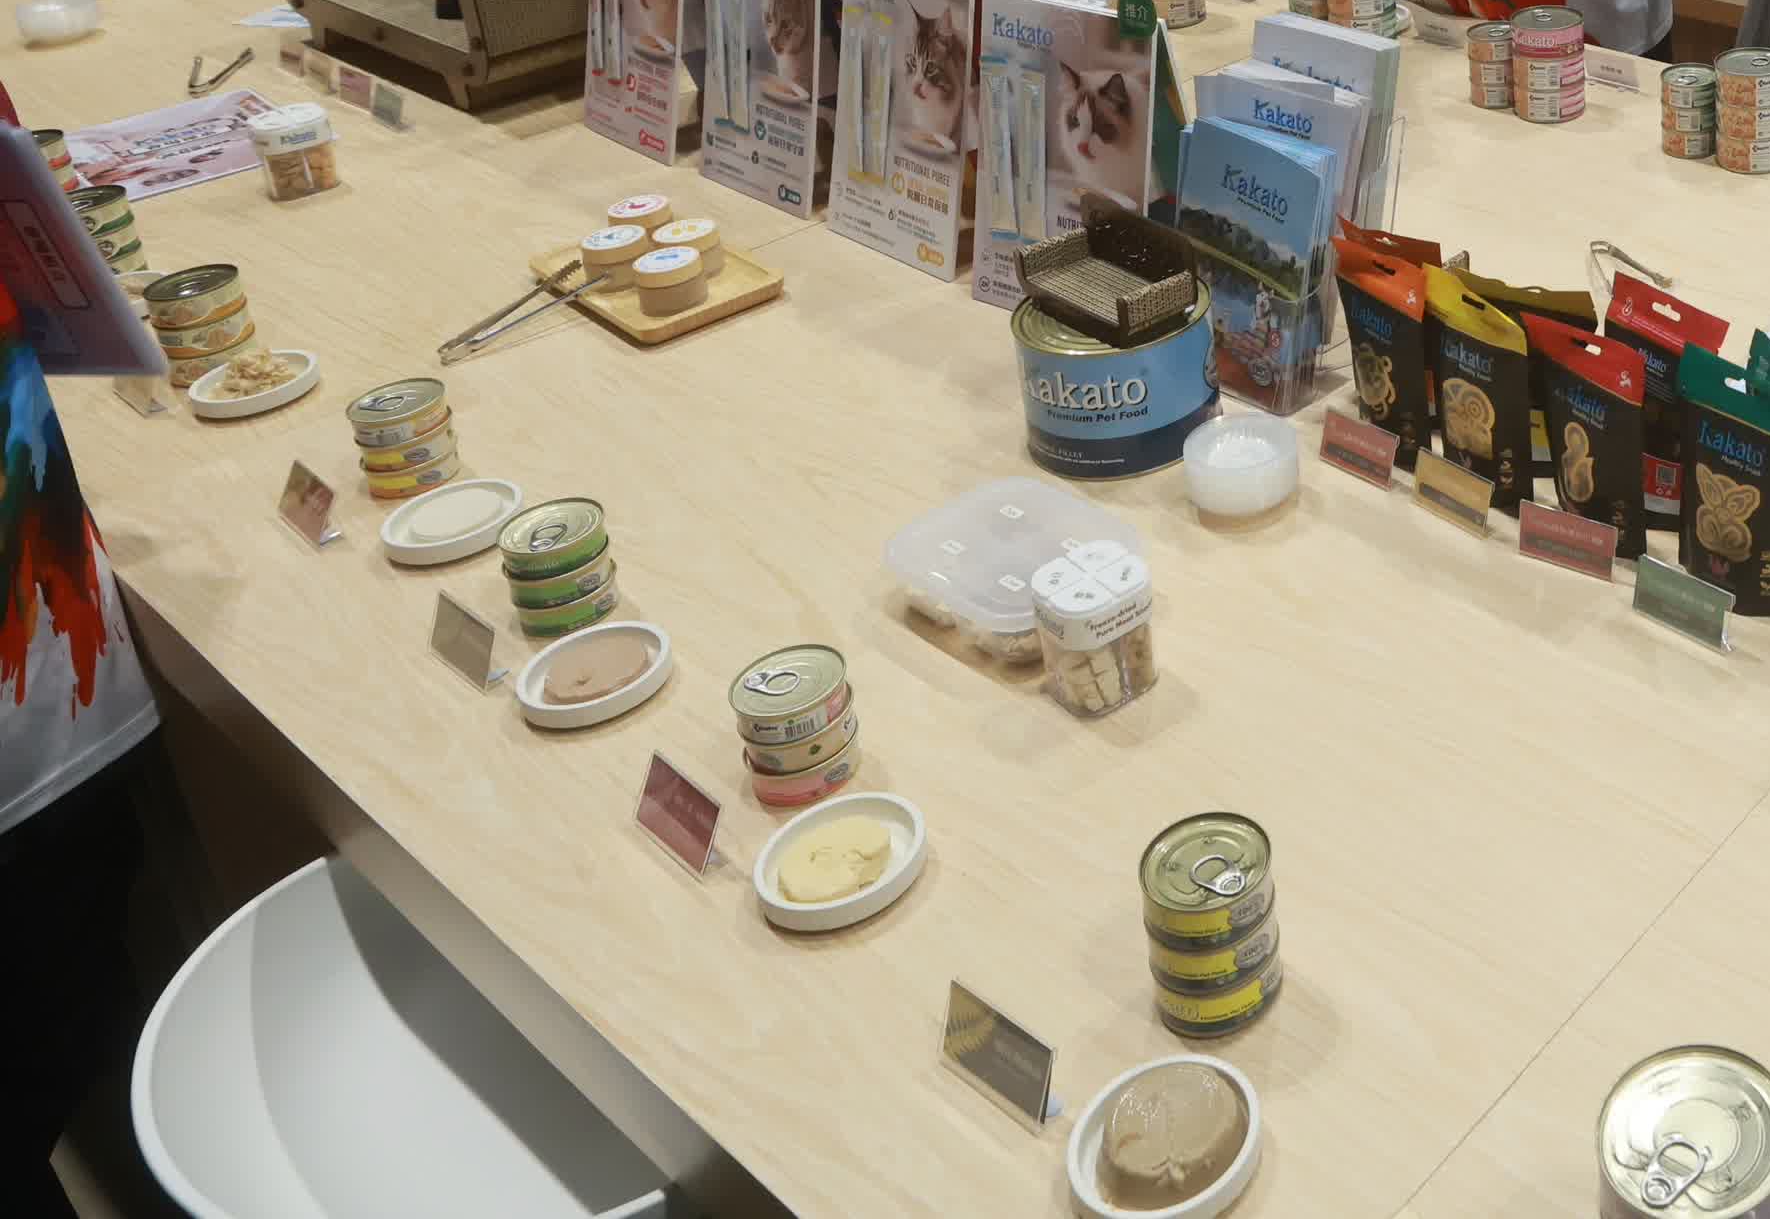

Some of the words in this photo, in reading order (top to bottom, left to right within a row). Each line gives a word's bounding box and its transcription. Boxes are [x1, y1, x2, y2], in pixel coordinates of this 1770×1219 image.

[991, 11, 1055, 47] Kakato
[1125, 2, 1150, 21] 推介
[1253, 98, 1314, 134] Kakato
[1219, 163, 1290, 217] Kakato
[1047, 409, 1094, 423] Premium
[1096, 409, 1116, 422] Pet
[1119, 405, 1150, 421] Food
[1699, 421, 1767, 468] Kakato
